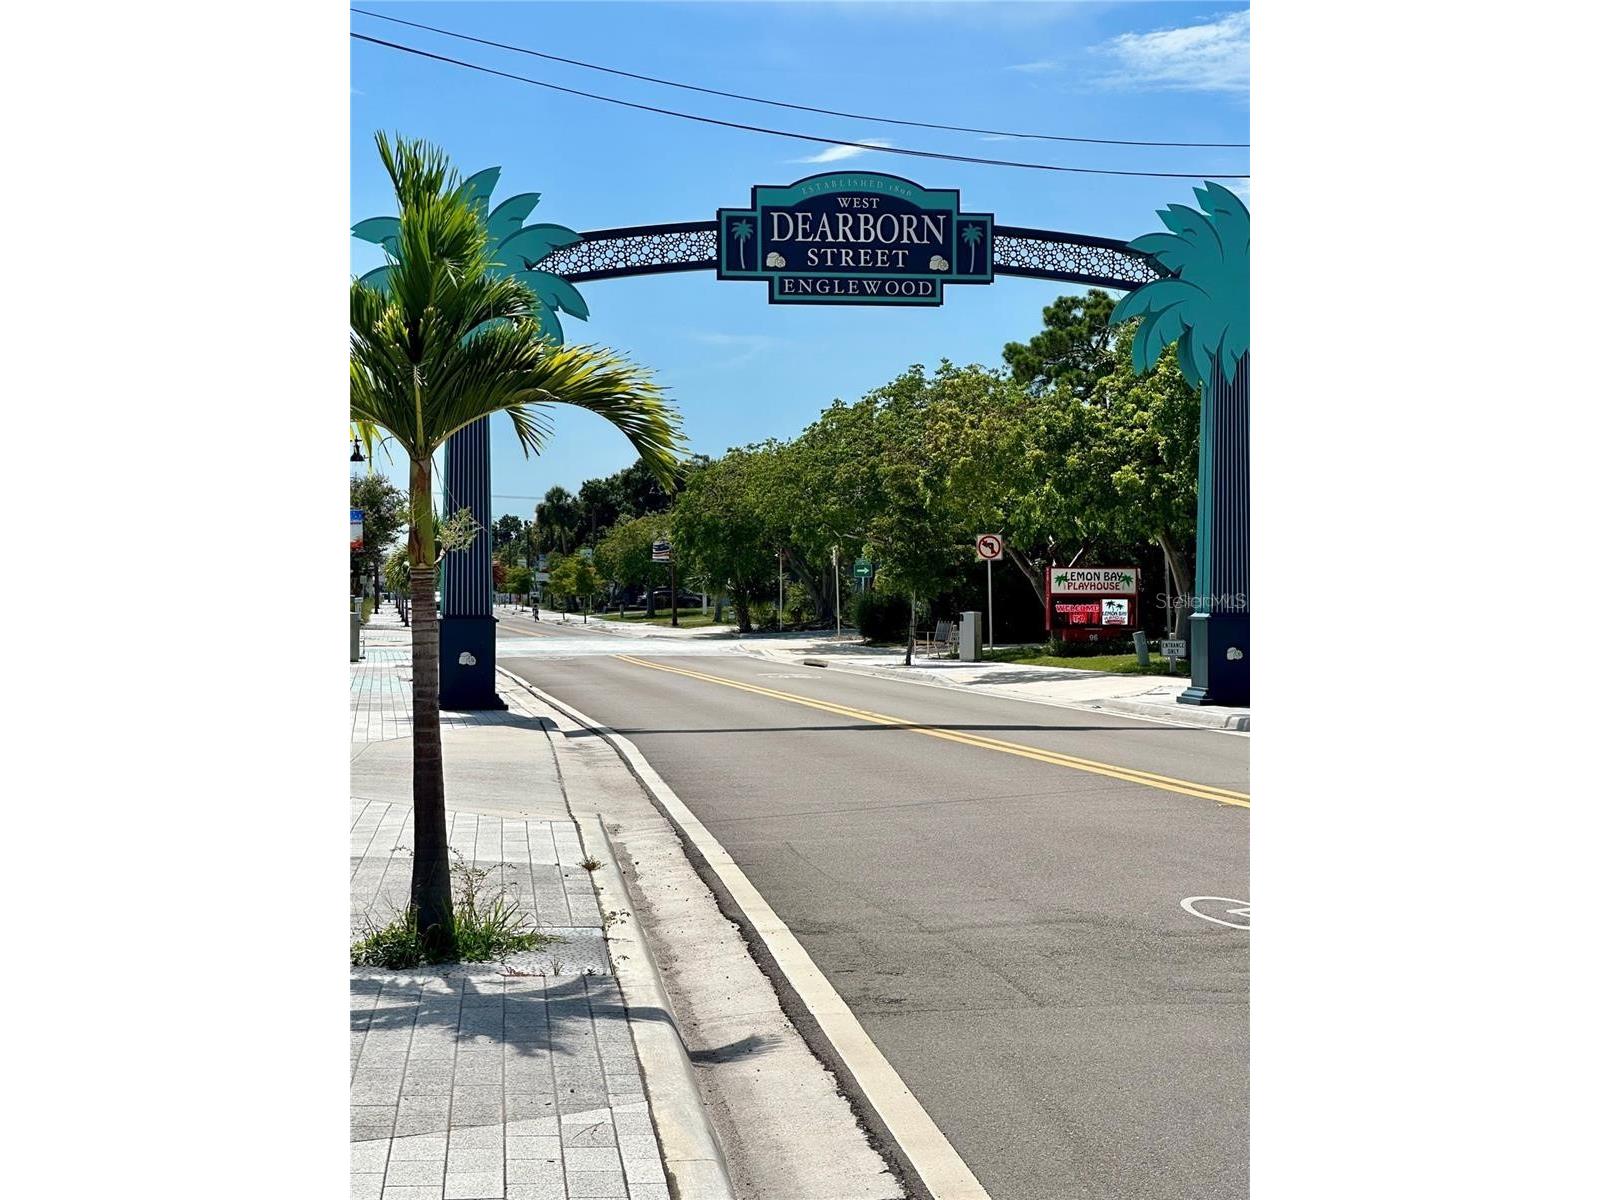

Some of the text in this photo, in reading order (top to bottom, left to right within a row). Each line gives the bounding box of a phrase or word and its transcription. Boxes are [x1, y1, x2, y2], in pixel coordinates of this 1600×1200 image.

[801, 179, 884, 195] ESTABLISHED
[837, 197, 880, 208] WEST
[770, 212, 946, 244] DEARBORN
[807, 248, 909, 267] STREET
[783, 279, 933, 296] ENGLEWOOD
[1065, 572, 1123, 581] LEMON BAY
[1067, 582, 1120, 590] PLAYHOUSE
[1055, 604, 1099, 612] WELCOME
